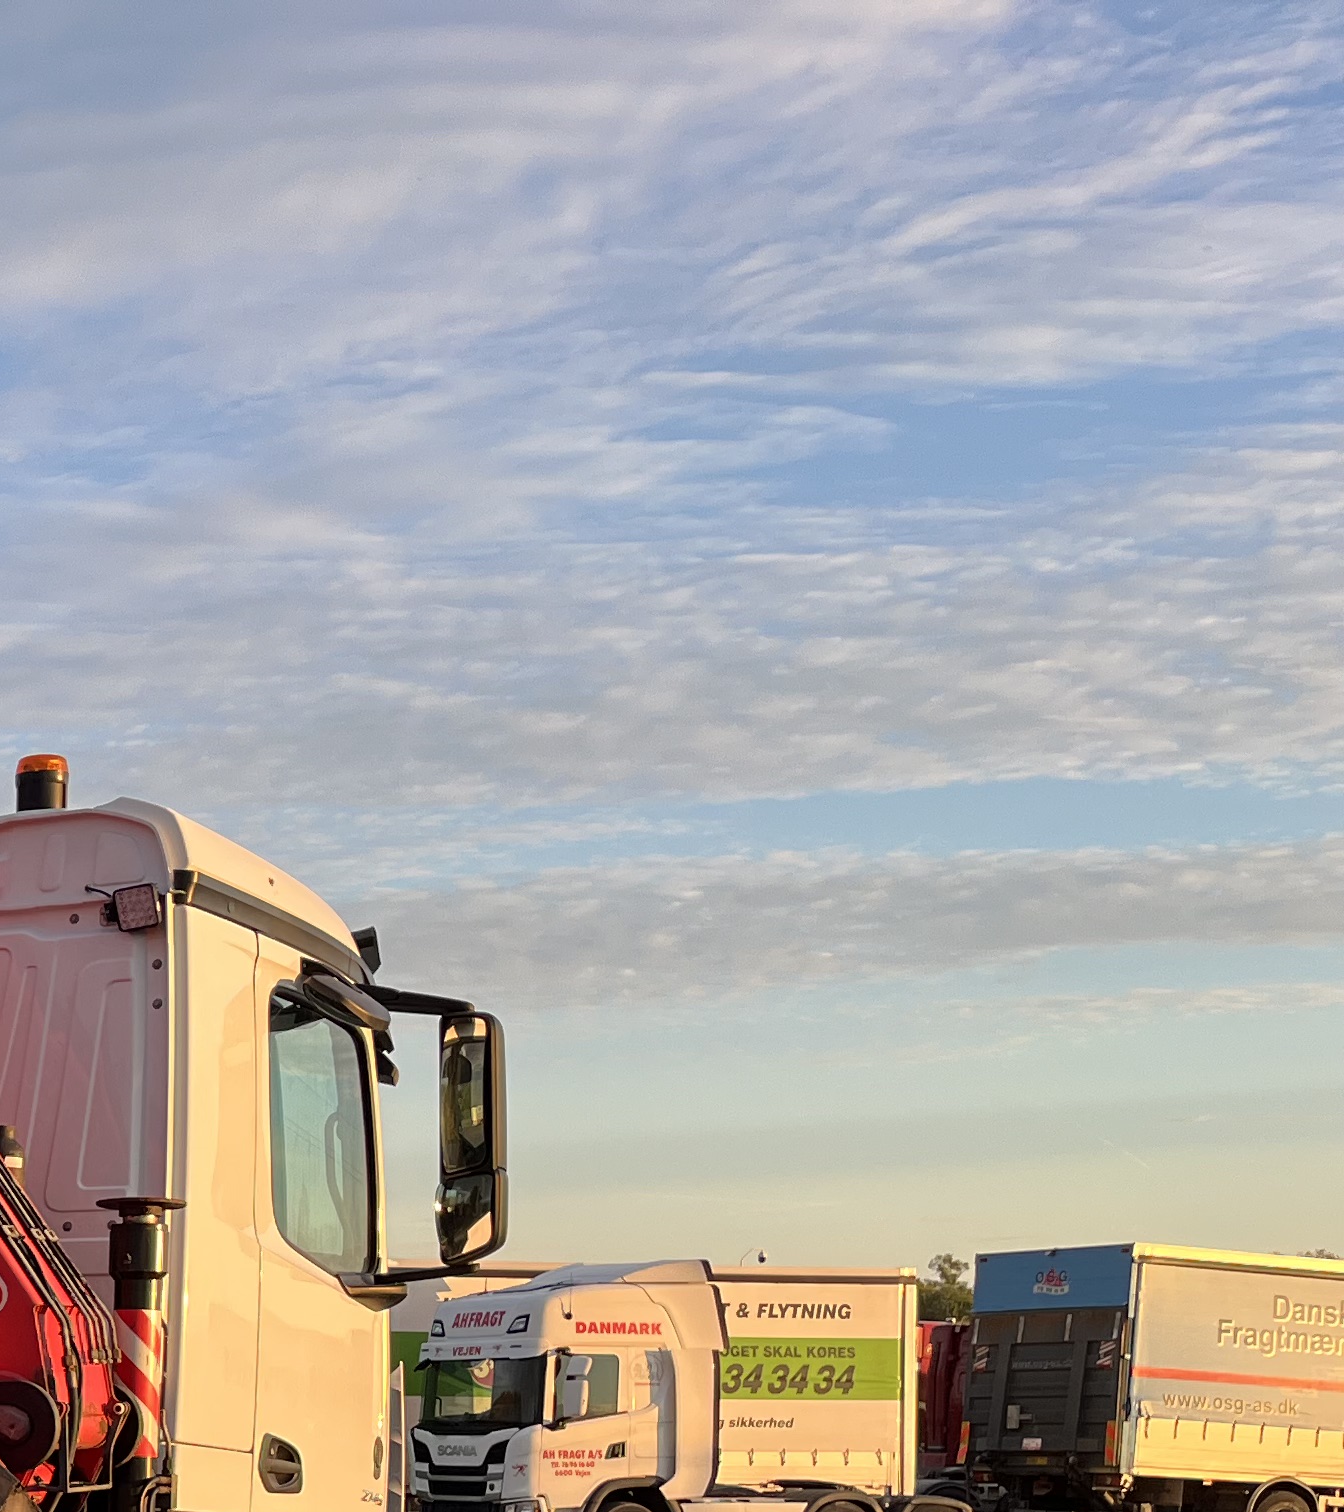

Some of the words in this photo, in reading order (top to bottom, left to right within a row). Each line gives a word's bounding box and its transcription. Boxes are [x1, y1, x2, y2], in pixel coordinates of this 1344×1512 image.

[736, 1303, 749, 1318] &
[757, 1303, 852, 1320] FLYTNING
[575, 1321, 662, 1335] DANMARK
[452, 1346, 482, 1356] VEJEN
[763, 1346, 802, 1358] SKAL
[806, 1347, 856, 1359] KØRES
[722, 1364, 764, 1394] 34
[767, 1364, 810, 1395] 34
[813, 1364, 856, 1395] 34
[1163, 1393, 1300, 1416] www.osg-as.dk
[729, 1417, 795, 1428] sikkerhed
[437, 1445, 478, 1457] SCANIA
[543, 1450, 556, 1460] AH
[558, 1450, 586, 1460] FRAGT
[588, 1450, 603, 1460] A/S
